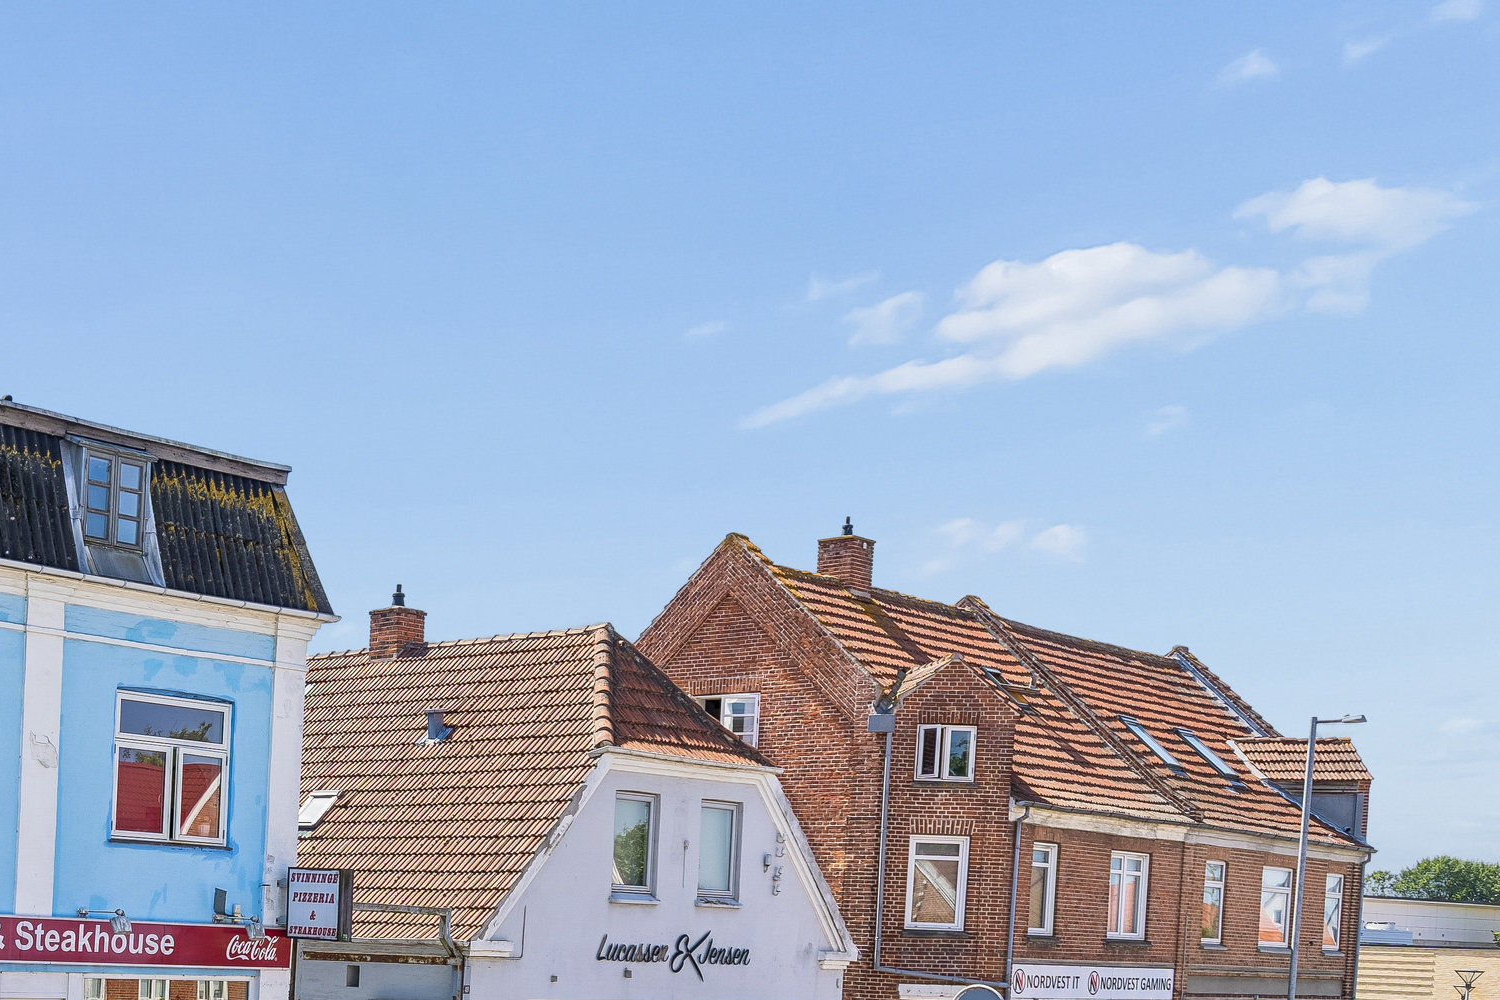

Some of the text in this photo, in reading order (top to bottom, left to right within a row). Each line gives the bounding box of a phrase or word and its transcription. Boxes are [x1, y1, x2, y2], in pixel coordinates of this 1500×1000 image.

[290, 872, 339, 884] SVINNINGE
[292, 891, 335, 904] PIZZERIA
[309, 910, 316, 920] &
[14, 920, 175, 956] Steakhouse
[289, 925, 337, 937] STEAKHOUSE
[226, 934, 279, 961] Coca-Cola
[596, 933, 669, 963] Lucassen
[699, 938, 751, 966] Jensen
[1026, 974, 1071, 990] NORDVEST
[1073, 975, 1080, 989] IT
[1100, 976, 1140, 991] NORDVEST
[1141, 977, 1172, 991] GAMING
